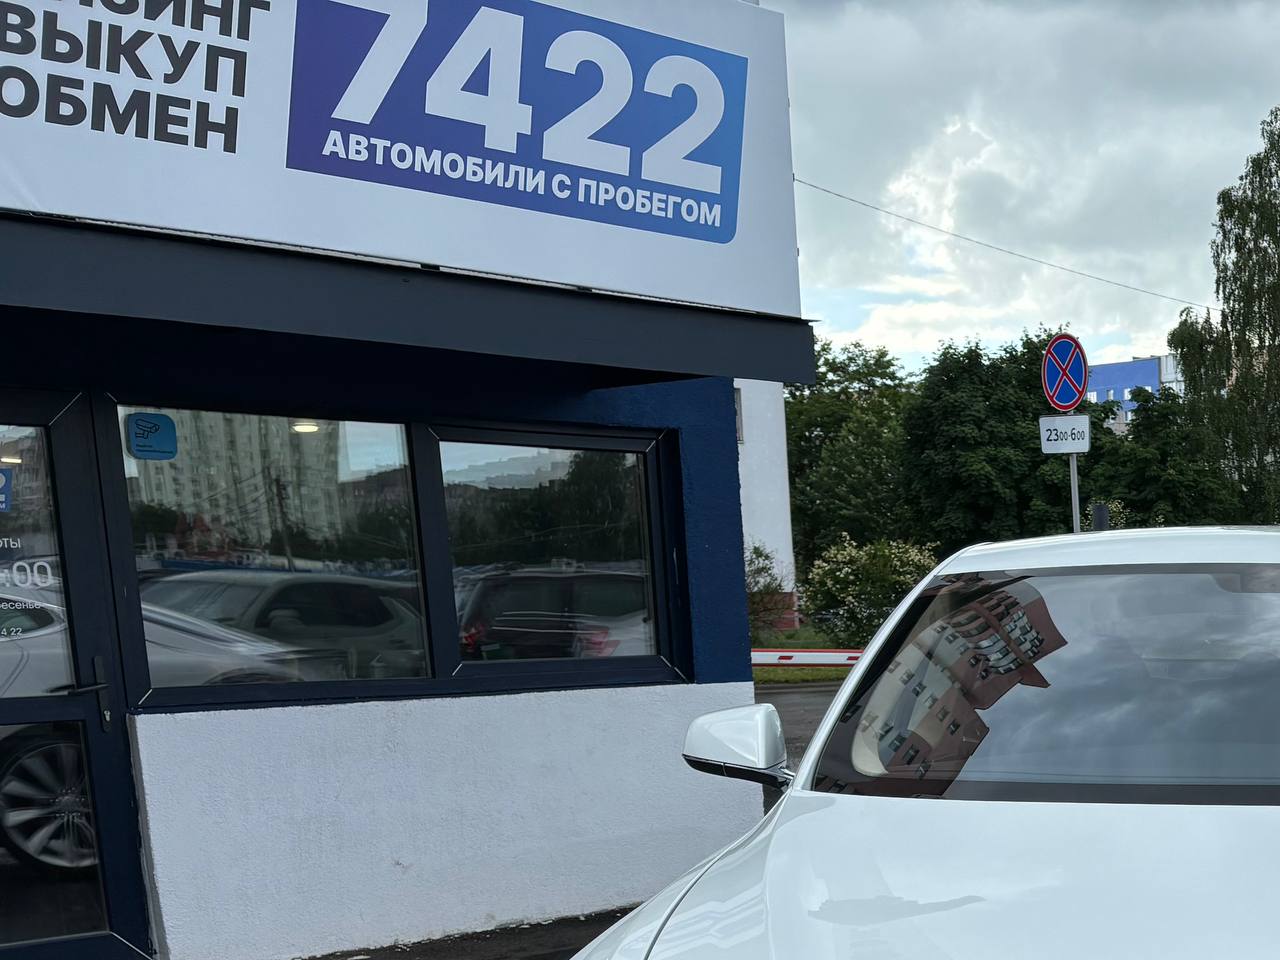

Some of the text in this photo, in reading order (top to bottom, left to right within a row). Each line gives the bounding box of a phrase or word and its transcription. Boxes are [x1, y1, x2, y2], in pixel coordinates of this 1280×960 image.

[0, 1, 248, 98] ВЫКУП
[331, 0, 725, 195] 7422
[0, 65, 239, 154] ОБМЕН
[321, 130, 721, 228] АВТОМОБИЛИ С ПРОБЕГОМ
